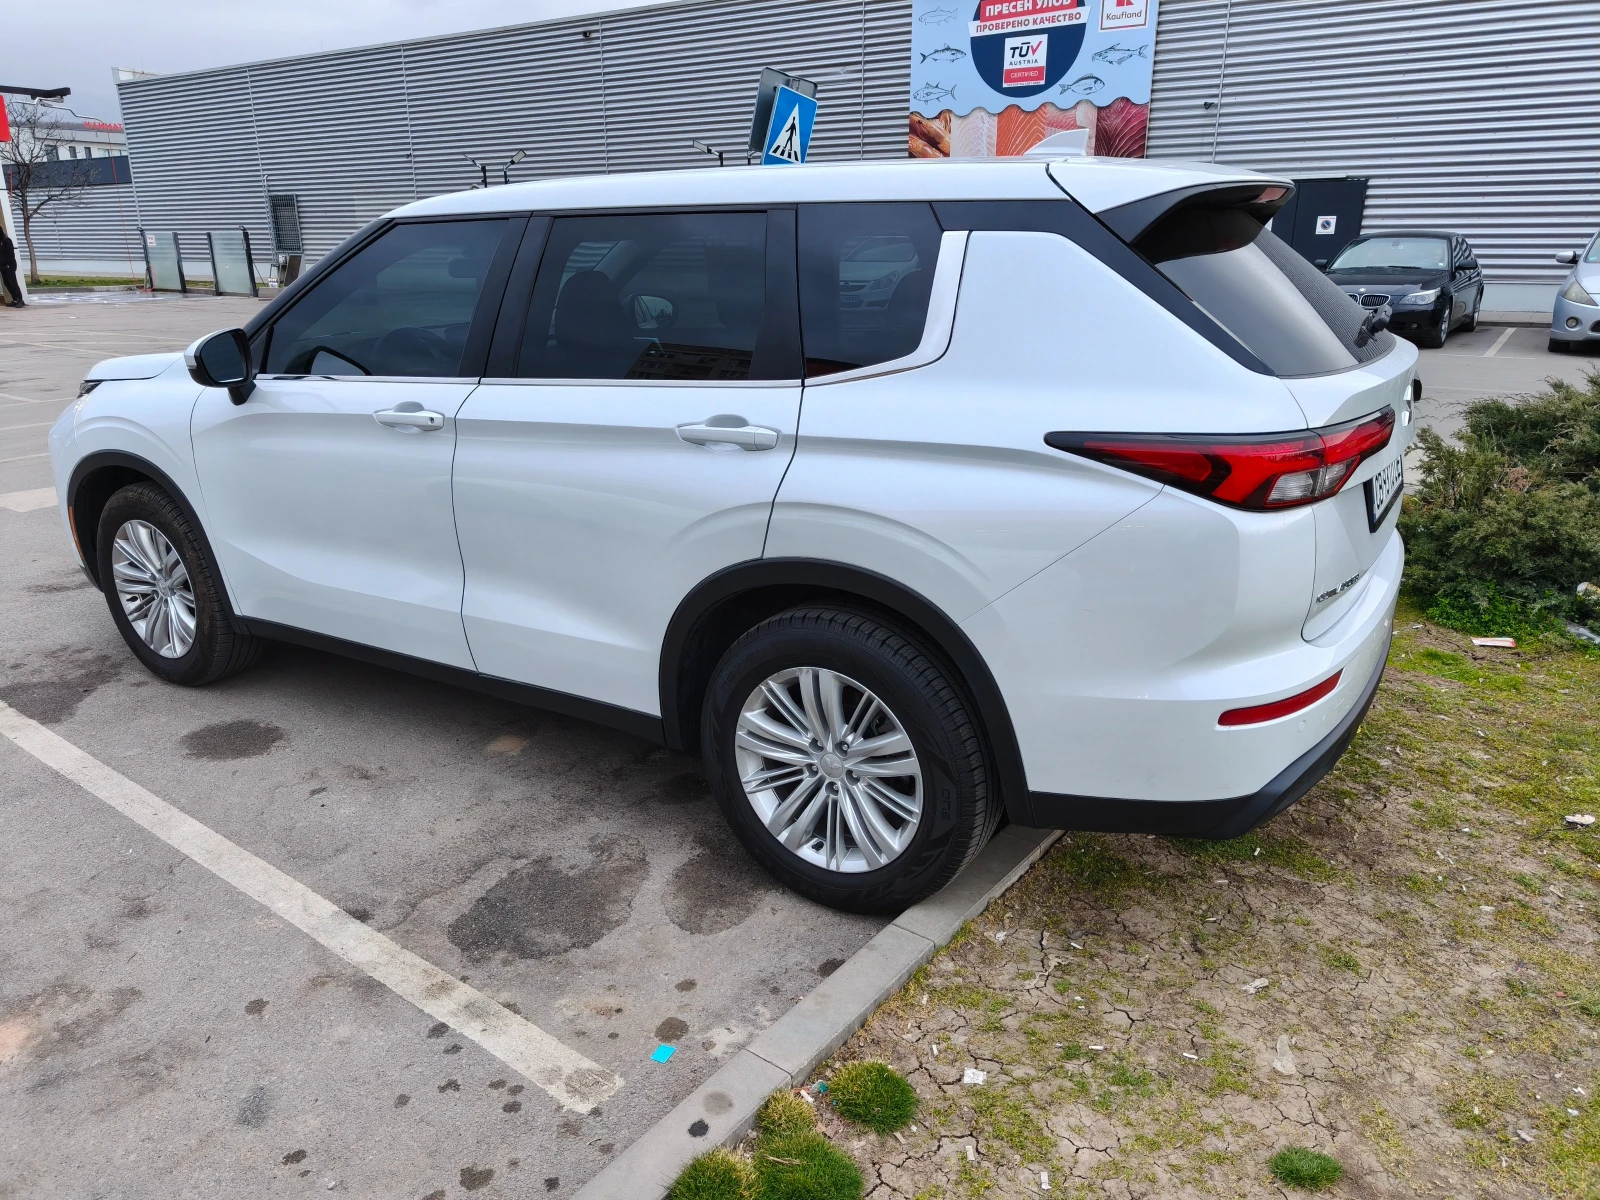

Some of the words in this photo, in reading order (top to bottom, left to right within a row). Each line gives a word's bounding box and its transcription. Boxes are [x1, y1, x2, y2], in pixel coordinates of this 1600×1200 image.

[985, 0, 1033, 17] ПРЕСЕН
[1106, 9, 1142, 21] Kaufland
[976, 18, 1030, 33] ПРОВЕРЕНО
[1032, 12, 1082, 26] КАЧЕСТВО
[1010, 70, 1039, 78] CERTIFIED
